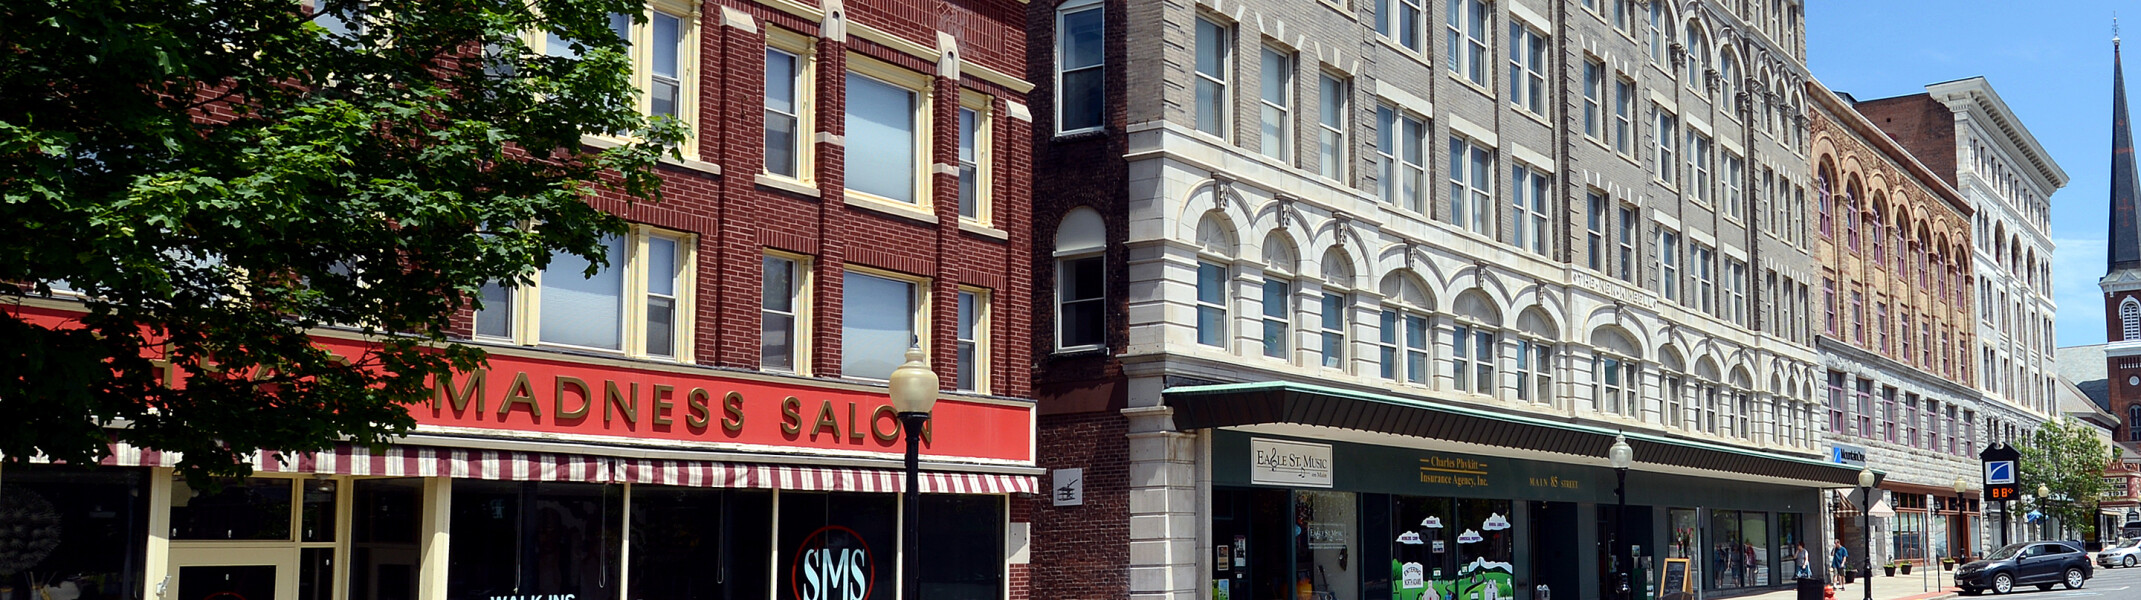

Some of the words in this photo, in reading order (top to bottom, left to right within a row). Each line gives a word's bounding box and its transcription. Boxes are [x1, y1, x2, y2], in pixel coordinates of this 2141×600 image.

[432, 368, 745, 432] MADNESS
[1430, 456, 1455, 468] Charles
[1420, 472, 1452, 484] Insurance
[1477, 475, 1488, 486] Inc.
[1529, 477, 1548, 487] MAIN
[1550, 475, 1559, 488] 85
[803, 548, 866, 600] SMS
